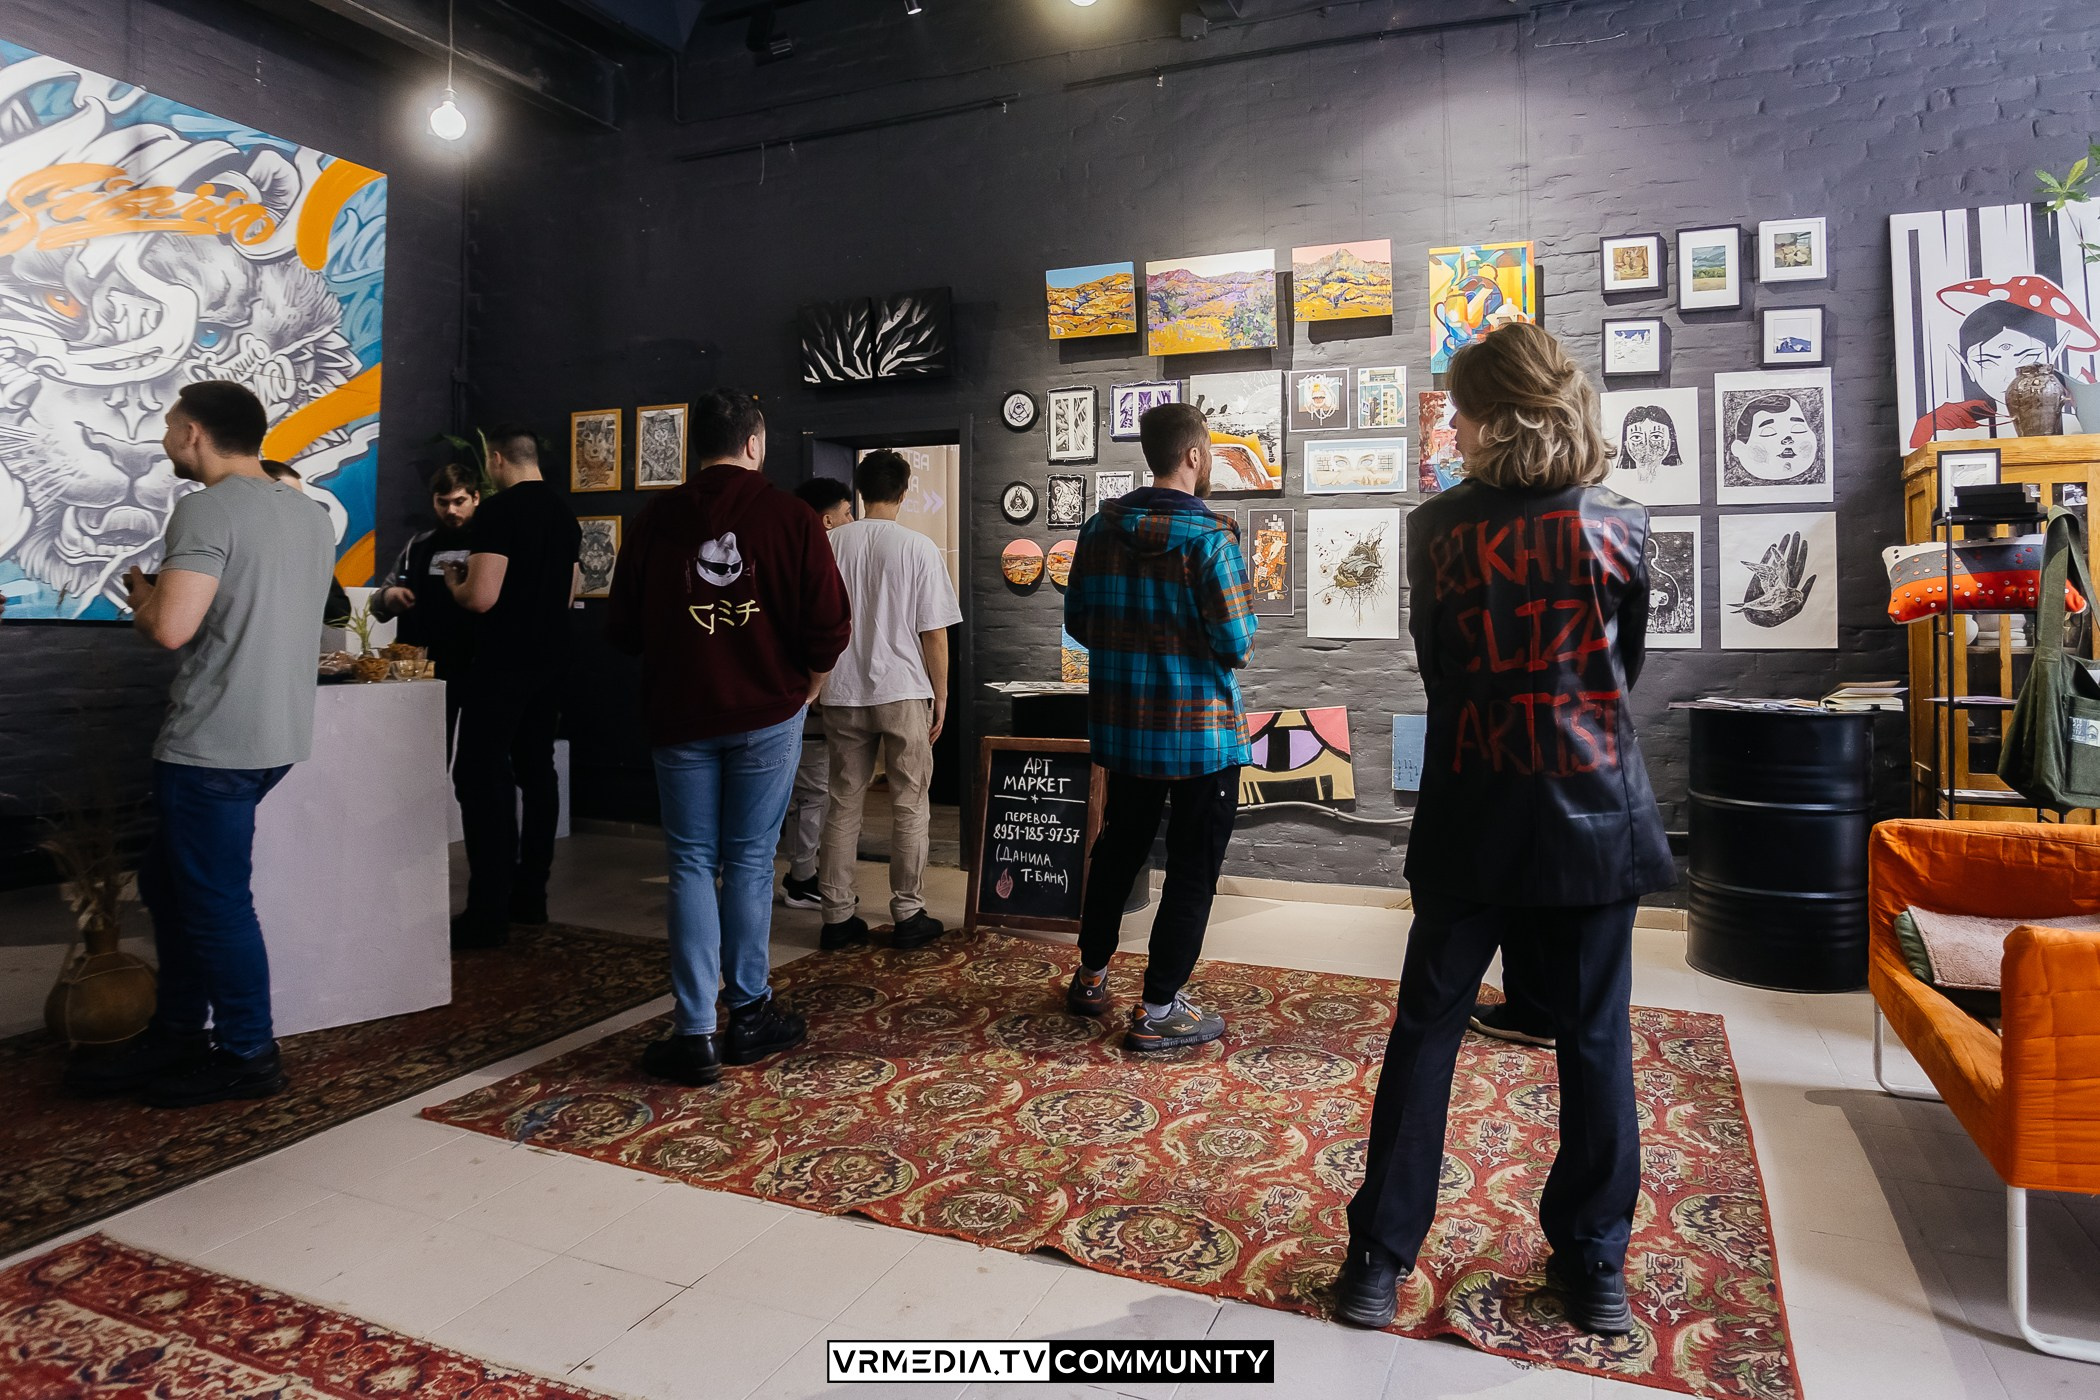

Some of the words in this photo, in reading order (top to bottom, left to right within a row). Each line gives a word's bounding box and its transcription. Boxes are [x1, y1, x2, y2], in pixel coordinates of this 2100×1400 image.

[1429, 510, 1631, 601] RIKHTER
[1452, 688, 1622, 778] ARTIST
[1023, 757, 1053, 776] АРТ
[1004, 777, 1071, 794] МАРКЕТ
[1005, 812, 1061, 824] ПЕРЕВОД
[993, 825, 1081, 844] 8951-185-97-57
